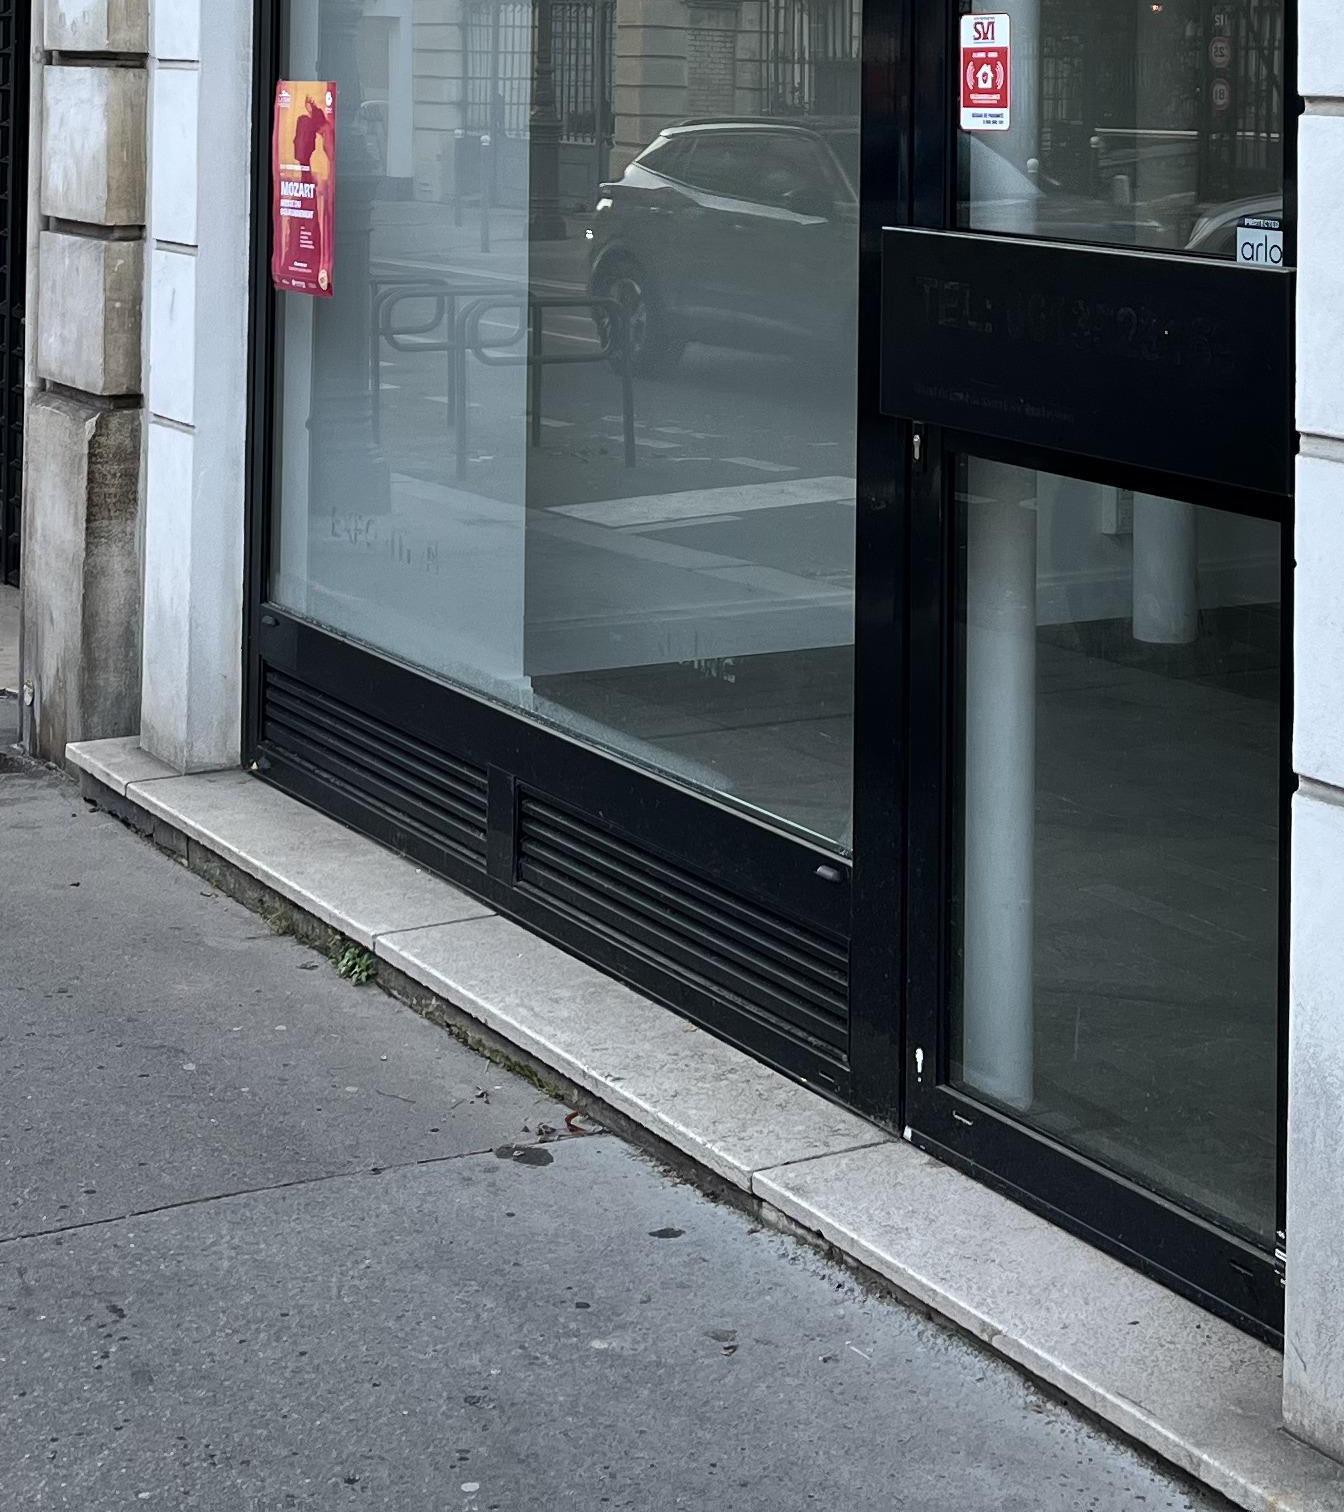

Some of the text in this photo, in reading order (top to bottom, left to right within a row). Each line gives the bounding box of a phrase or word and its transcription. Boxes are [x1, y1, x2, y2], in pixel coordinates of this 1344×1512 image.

[973, 21, 996, 41] SVI
[280, 180, 316, 199] MOZART
[1244, 218, 1280, 229] PROTECTED
[1241, 234, 1283, 264] arlo
